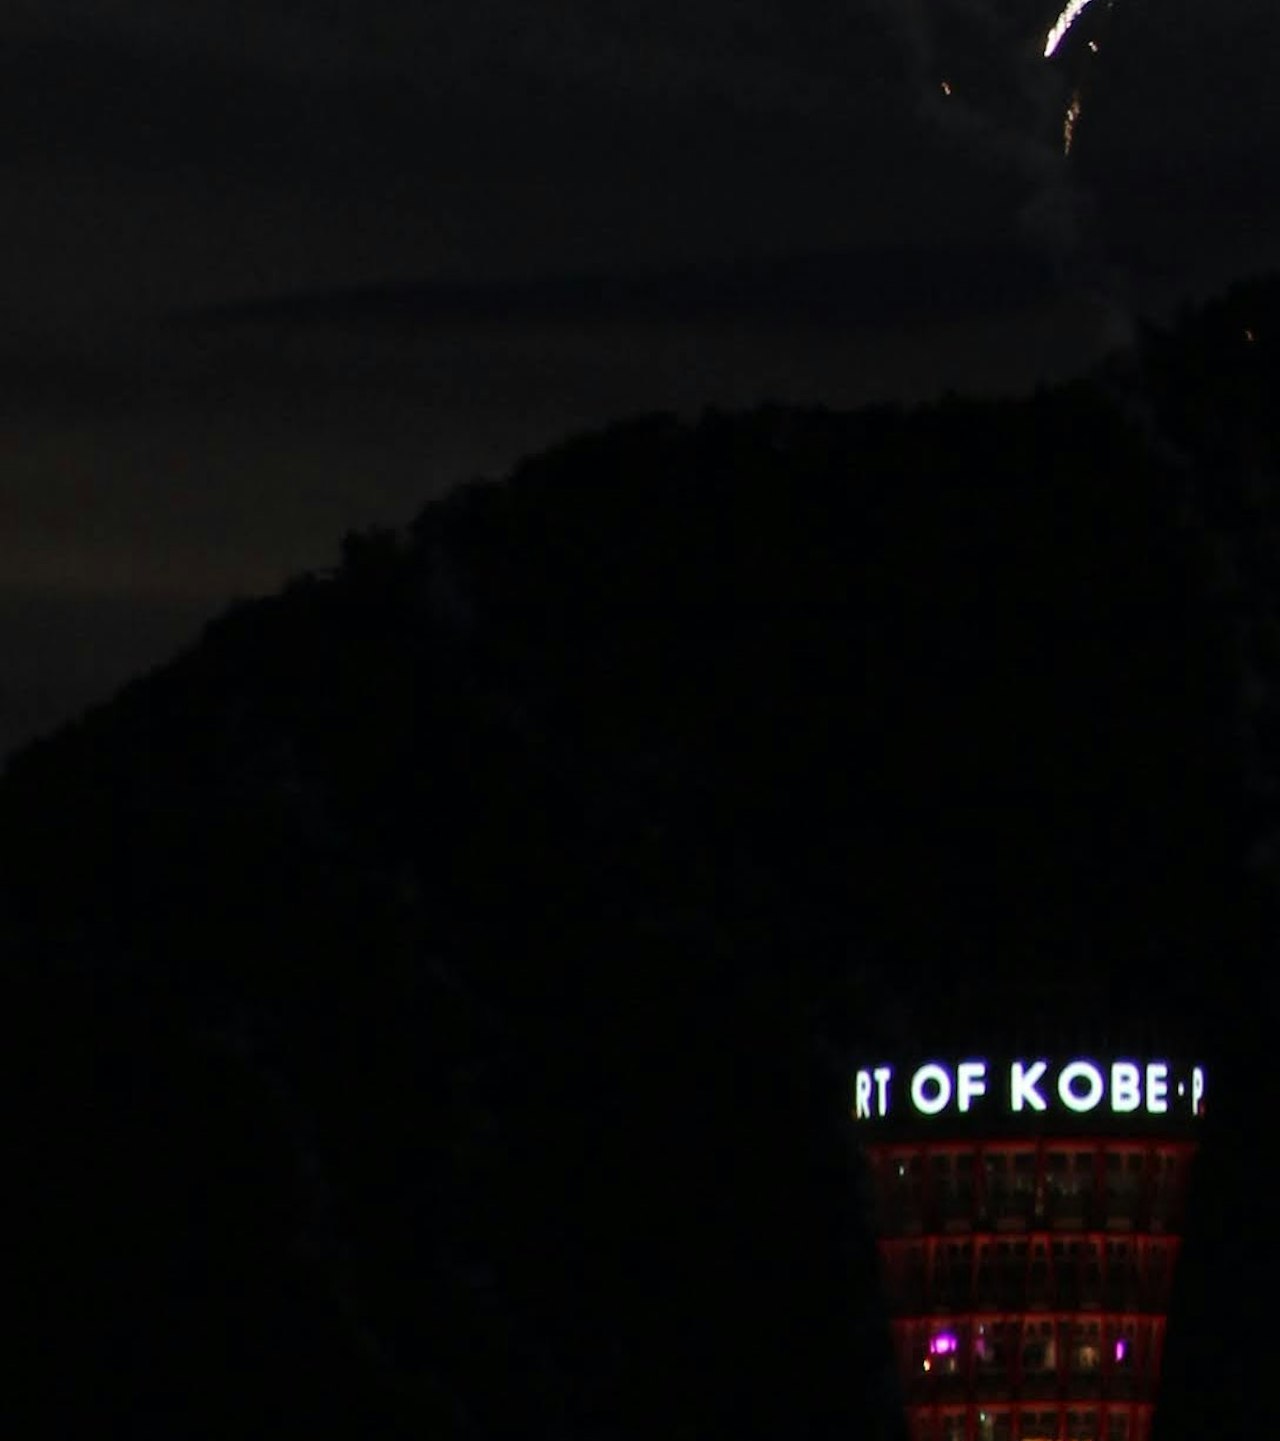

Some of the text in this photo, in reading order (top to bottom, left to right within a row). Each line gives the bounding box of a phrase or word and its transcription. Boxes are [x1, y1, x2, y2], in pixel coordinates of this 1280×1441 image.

[856, 1067, 891, 1119] RT
[911, 1063, 986, 1115] OF
[1011, 1061, 1168, 1114] KOBE
